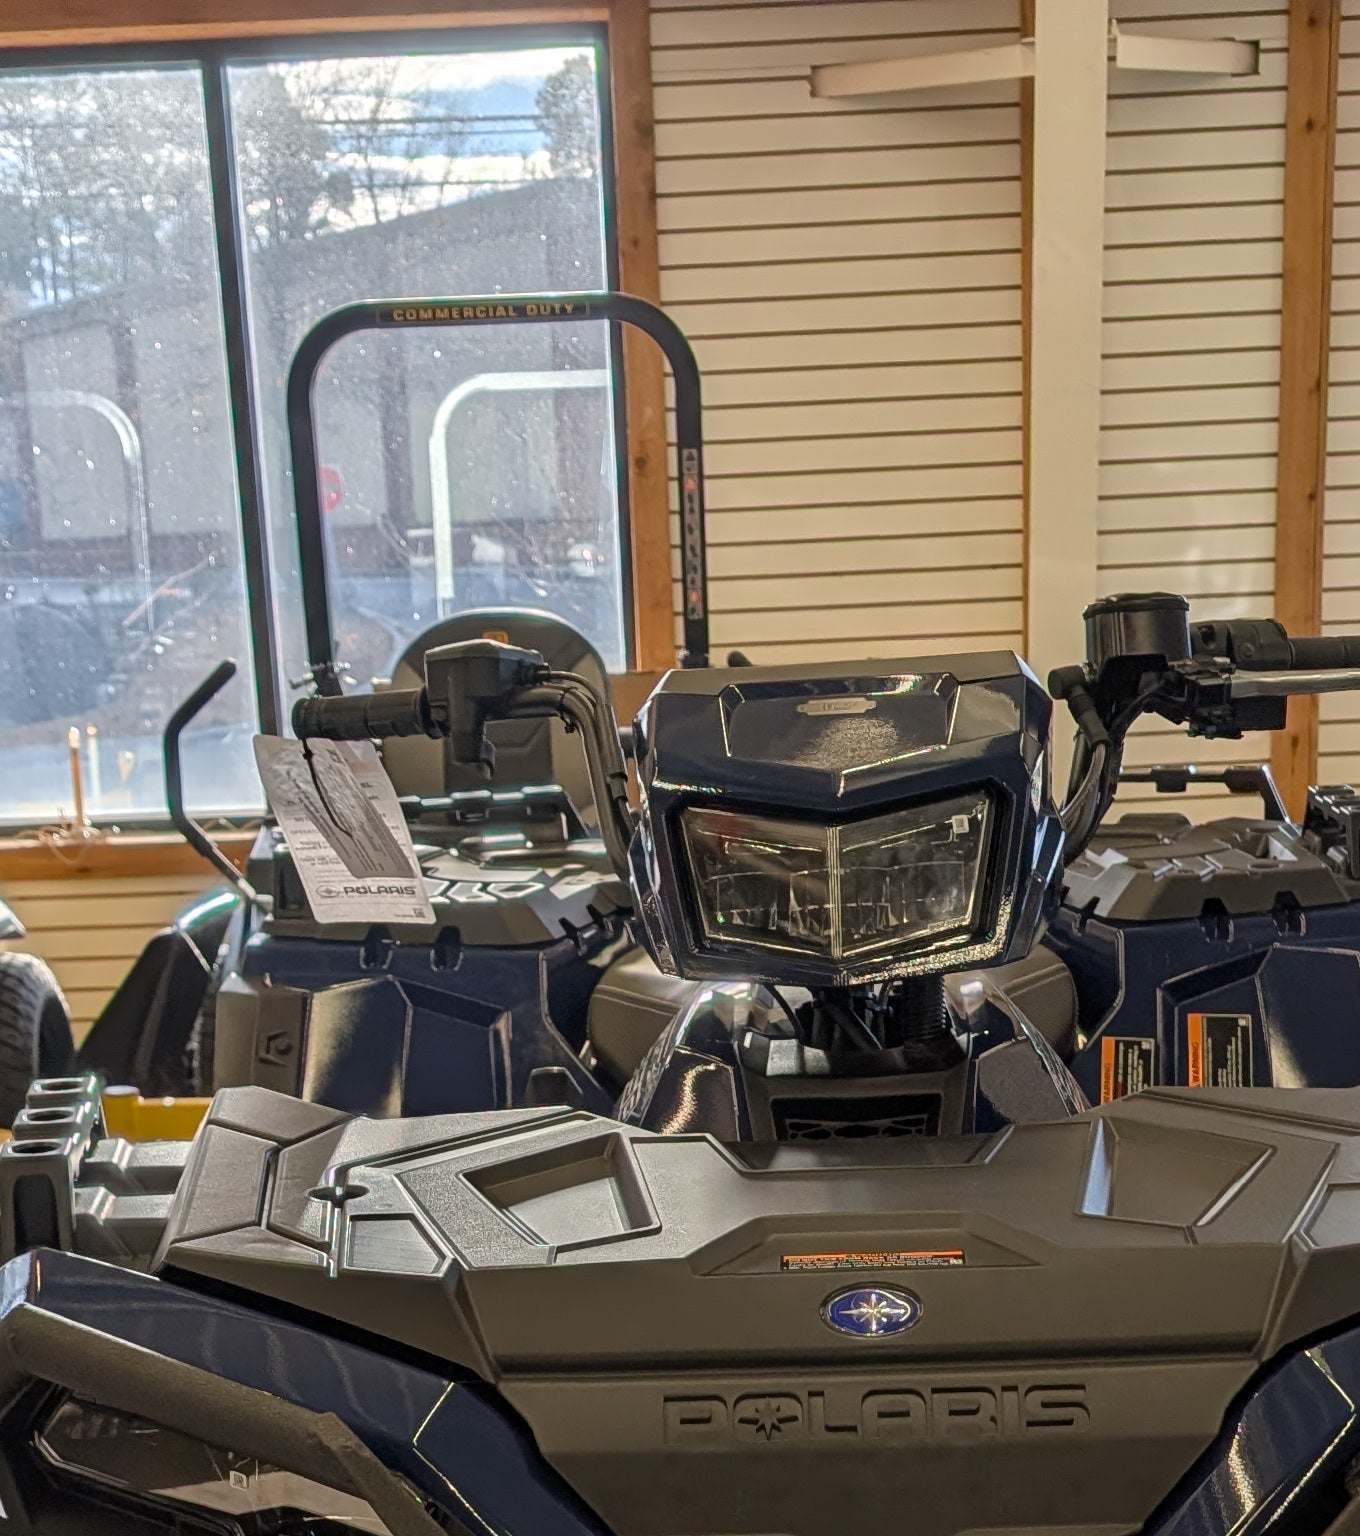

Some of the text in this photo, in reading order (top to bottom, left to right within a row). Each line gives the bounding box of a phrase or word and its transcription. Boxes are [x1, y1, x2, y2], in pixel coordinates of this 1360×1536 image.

[392, 302, 575, 322] COMMERCIAL DUTY
[343, 885, 417, 896] POLARIS
[662, 1383, 1092, 1446] POLARIS
